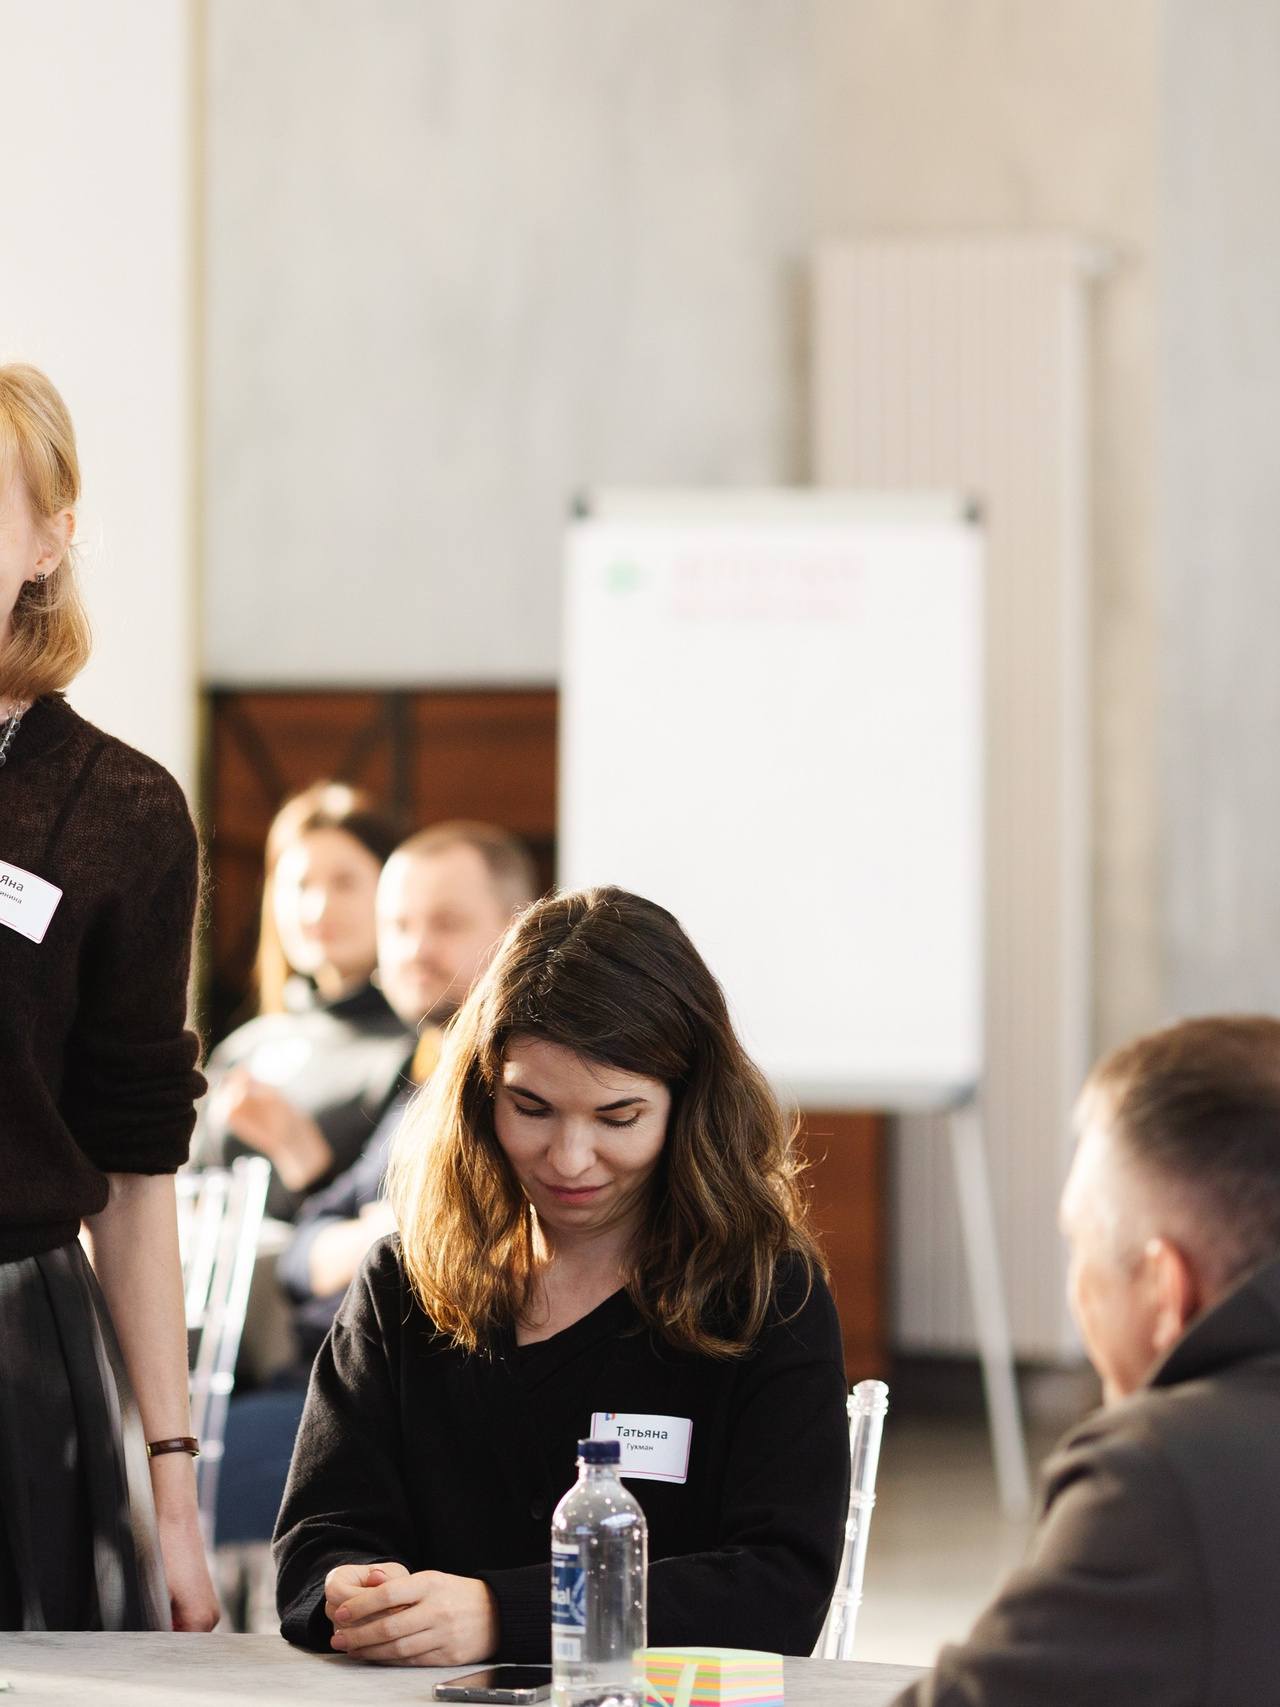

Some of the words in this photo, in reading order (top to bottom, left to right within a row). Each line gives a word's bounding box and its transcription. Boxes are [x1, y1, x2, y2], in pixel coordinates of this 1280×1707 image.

[0, 874, 24, 892] Яна
[616, 1426, 668, 1440] Татьяна
[626, 1442, 654, 1451] Гухман
